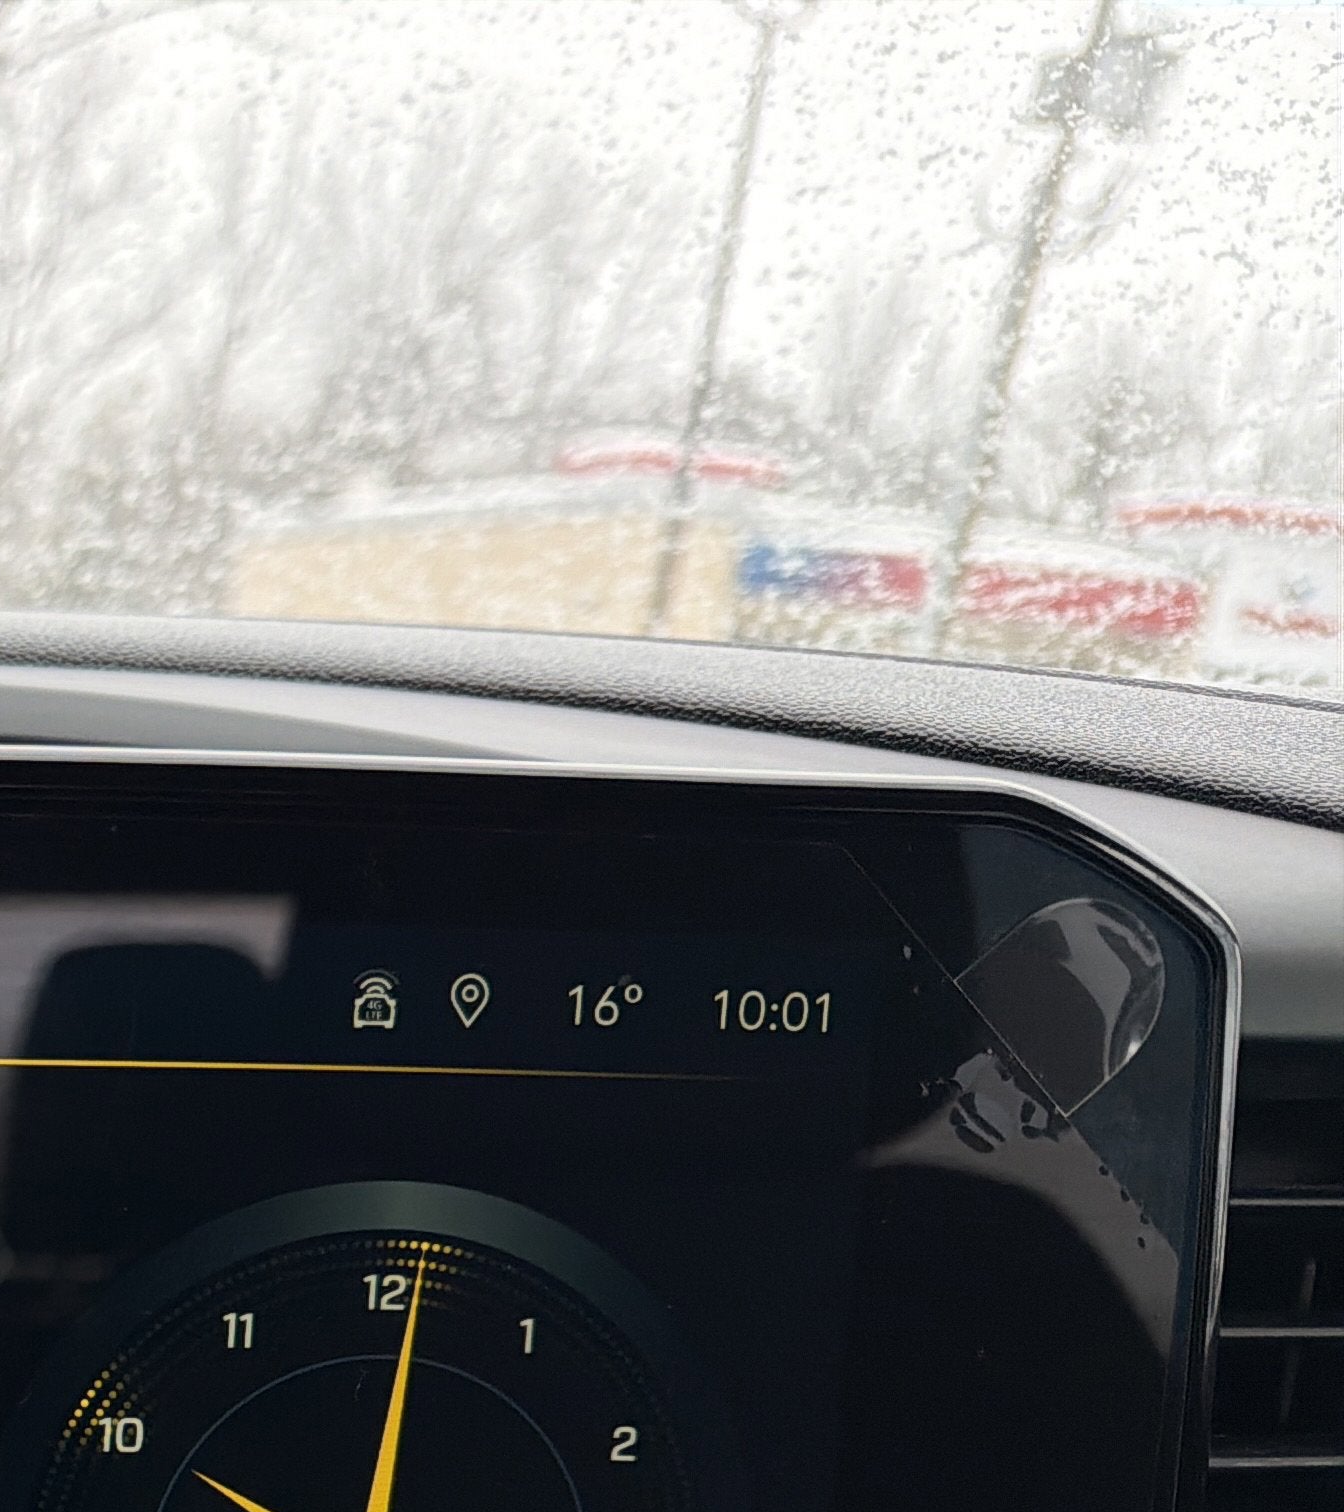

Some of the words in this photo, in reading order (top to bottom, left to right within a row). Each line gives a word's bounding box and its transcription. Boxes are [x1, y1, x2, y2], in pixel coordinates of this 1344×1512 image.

[367, 1000, 382, 1010] 4G
[568, 983, 644, 1026] 16°
[714, 989, 831, 1033] 10:01
[362, 1274, 407, 1311] 12
[222, 1312, 254, 1349] 11
[519, 1318, 535, 1354] 1
[98, 1416, 144, 1453] 10
[610, 1426, 638, 1462] 2
